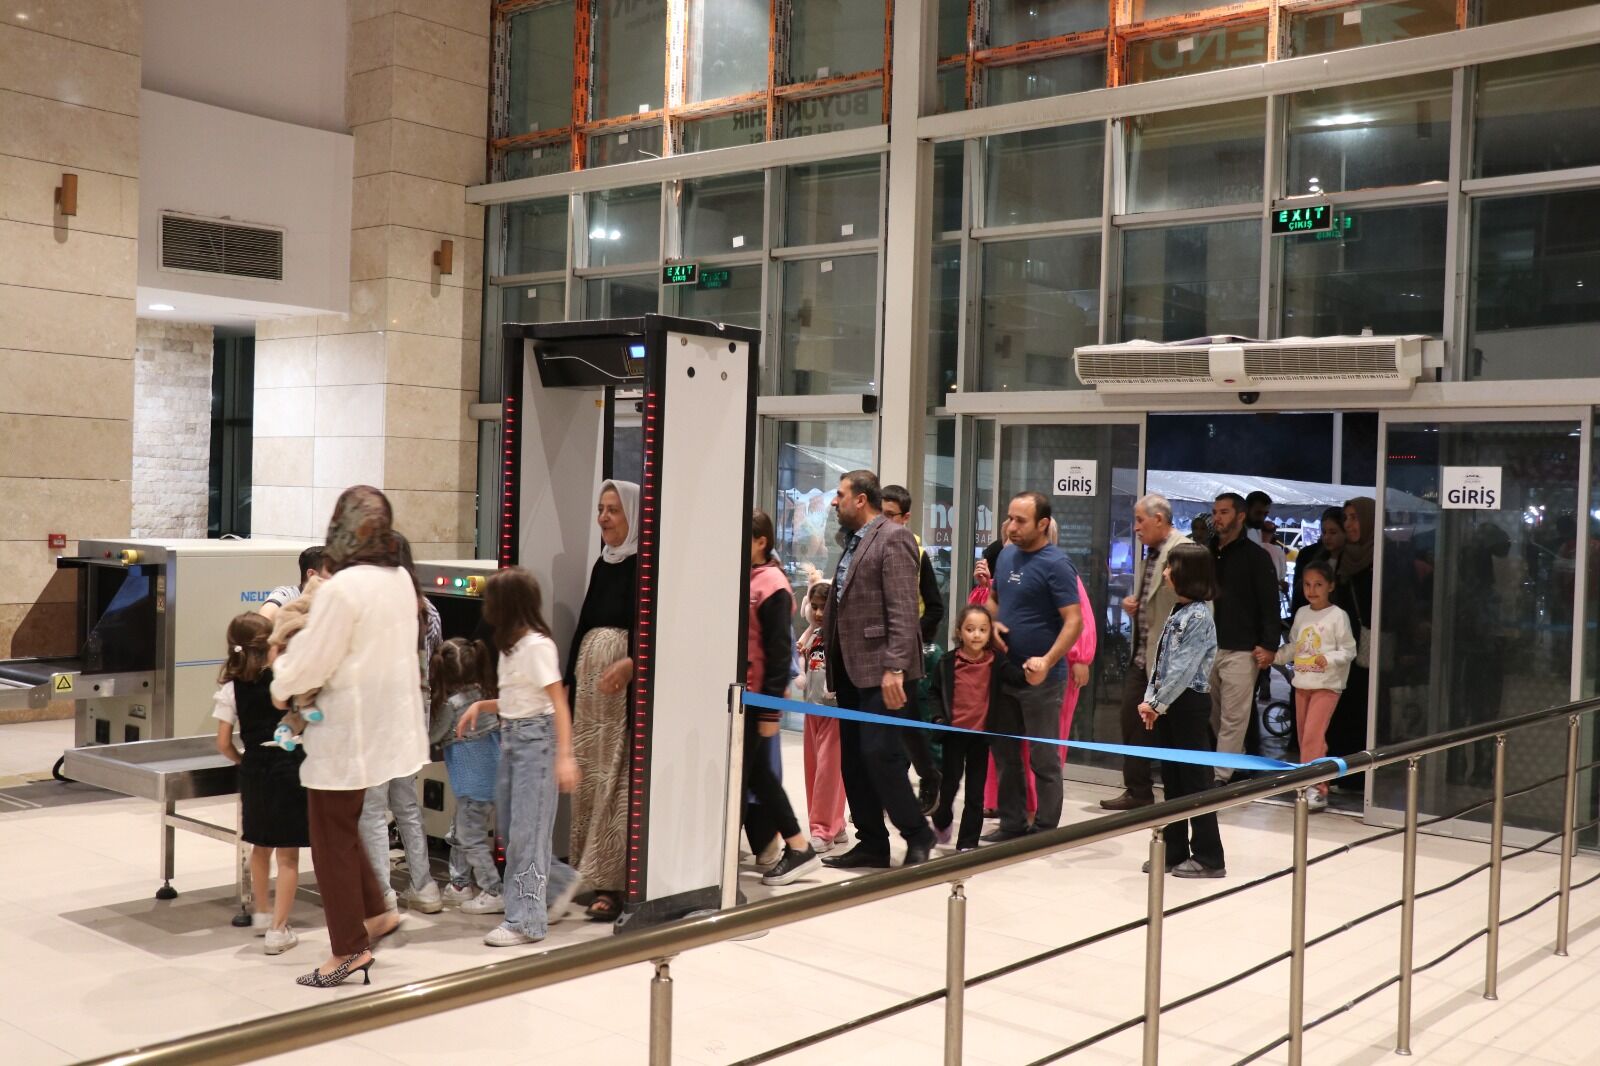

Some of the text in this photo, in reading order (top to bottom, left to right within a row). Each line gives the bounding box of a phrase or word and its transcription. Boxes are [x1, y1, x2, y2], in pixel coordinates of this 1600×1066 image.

[1279, 206, 1324, 223] EXIT
[1288, 220, 1313, 231] ÇIKIŞ
[667, 265, 693, 277] EXIT
[1057, 475, 1092, 495] GİRİŞ
[1447, 485, 1495, 508] GİRİŞ
